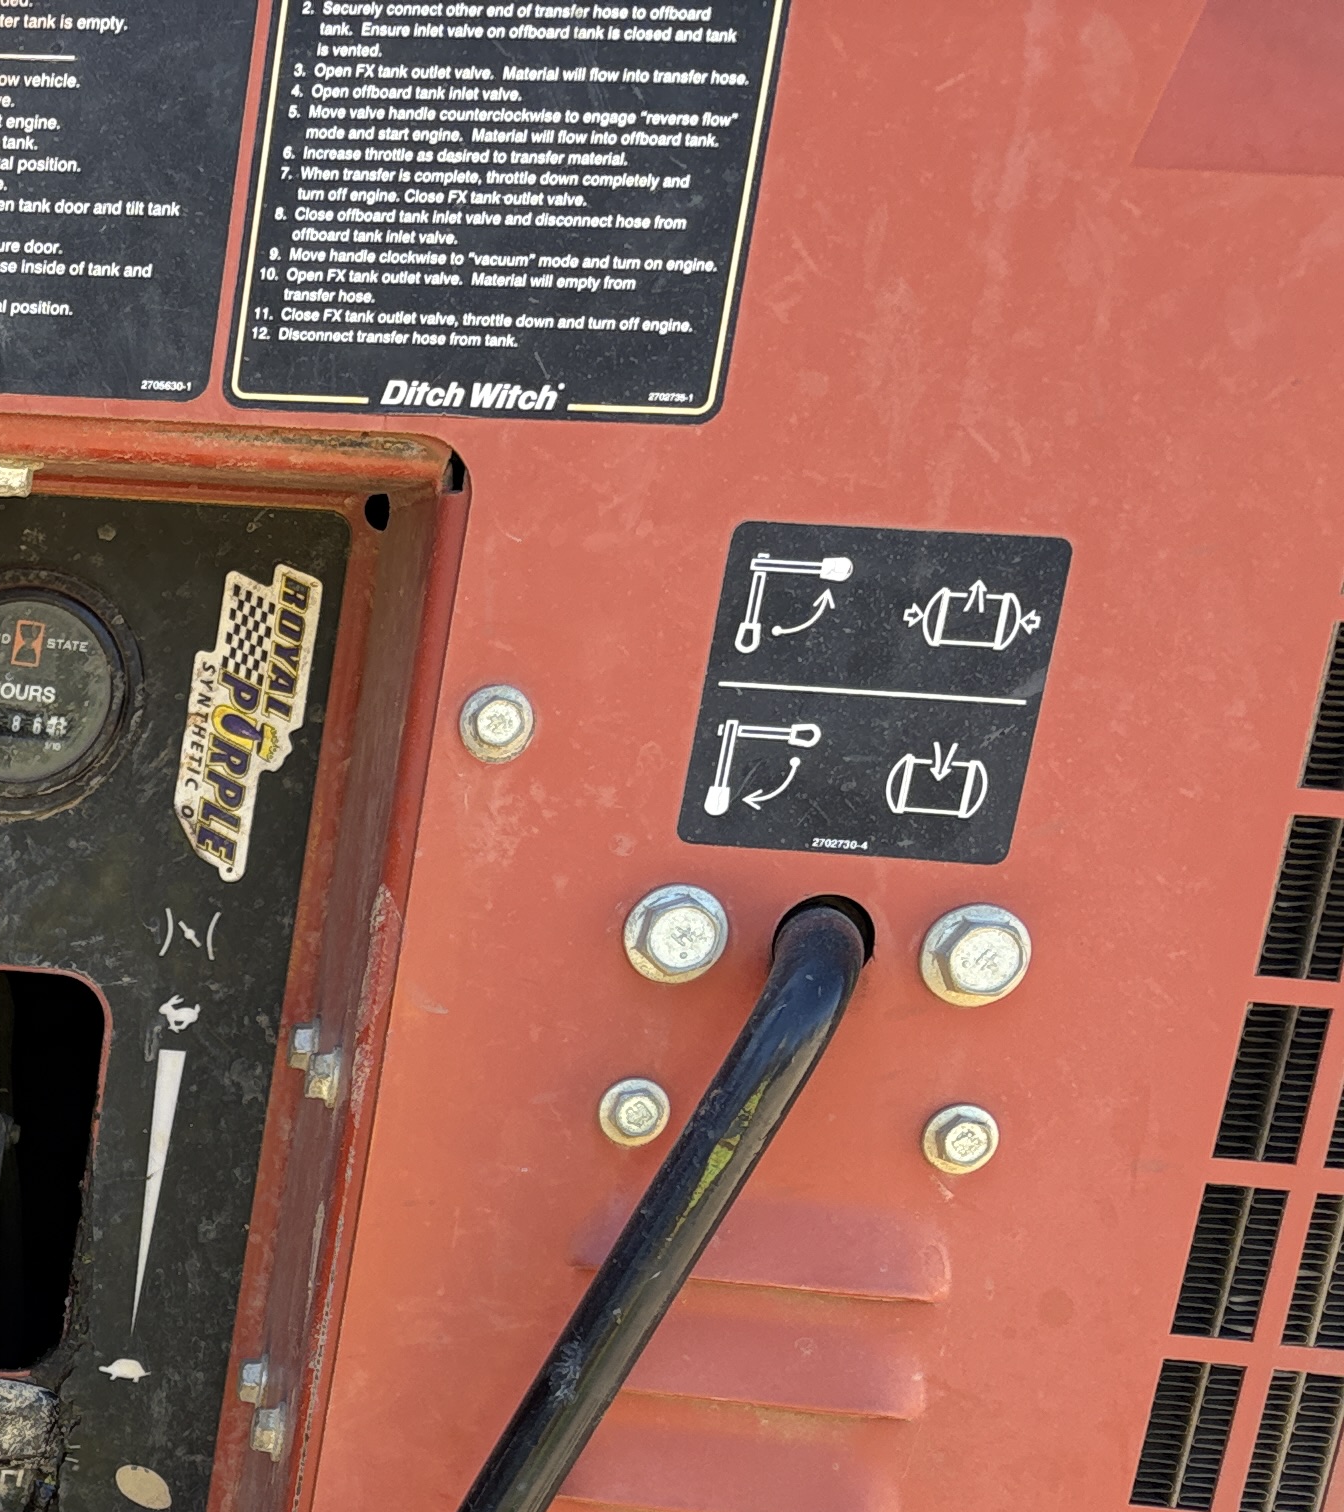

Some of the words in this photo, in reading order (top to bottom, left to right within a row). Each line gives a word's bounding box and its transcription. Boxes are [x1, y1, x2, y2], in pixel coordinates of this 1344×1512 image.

[23, 13, 57, 29] tank
[59, 13, 73, 30] is
[76, 15, 128, 34] empty.
[316, 42, 330, 57] is
[332, 43, 383, 58] vented.
[290, 83, 304, 98] 4.
[311, 83, 350, 102] Open
[352, 84, 413, 100] offboard
[415, 85, 446, 100] tank
[448, 85, 480, 101] inlet
[481, 86, 522, 102] valve.
[291, 227, 351, 242] offboard
[352, 229, 384, 243] tank
[385, 229, 417, 244] inlet
[418, 230, 458, 245] valve.
[283, 287, 337, 303] transfer
[337, 288, 376, 304] hose.
[251, 326, 271, 340] 12.
[278, 327, 355, 343] Disconnect
[356, 329, 410, 345] transfer
[411, 330, 447, 346] hose
[449, 331, 482, 347] from
[484, 333, 518, 348] tank.
[380, 380, 466, 407] Ditch
[47, 638, 88, 652] STATE
[262, 572, 313, 721] ROYAL
[185, 661, 215, 791] SYNTHETIC
[196, 668, 263, 866] PURPLE
[812, 838, 868, 850] 2702730-4
